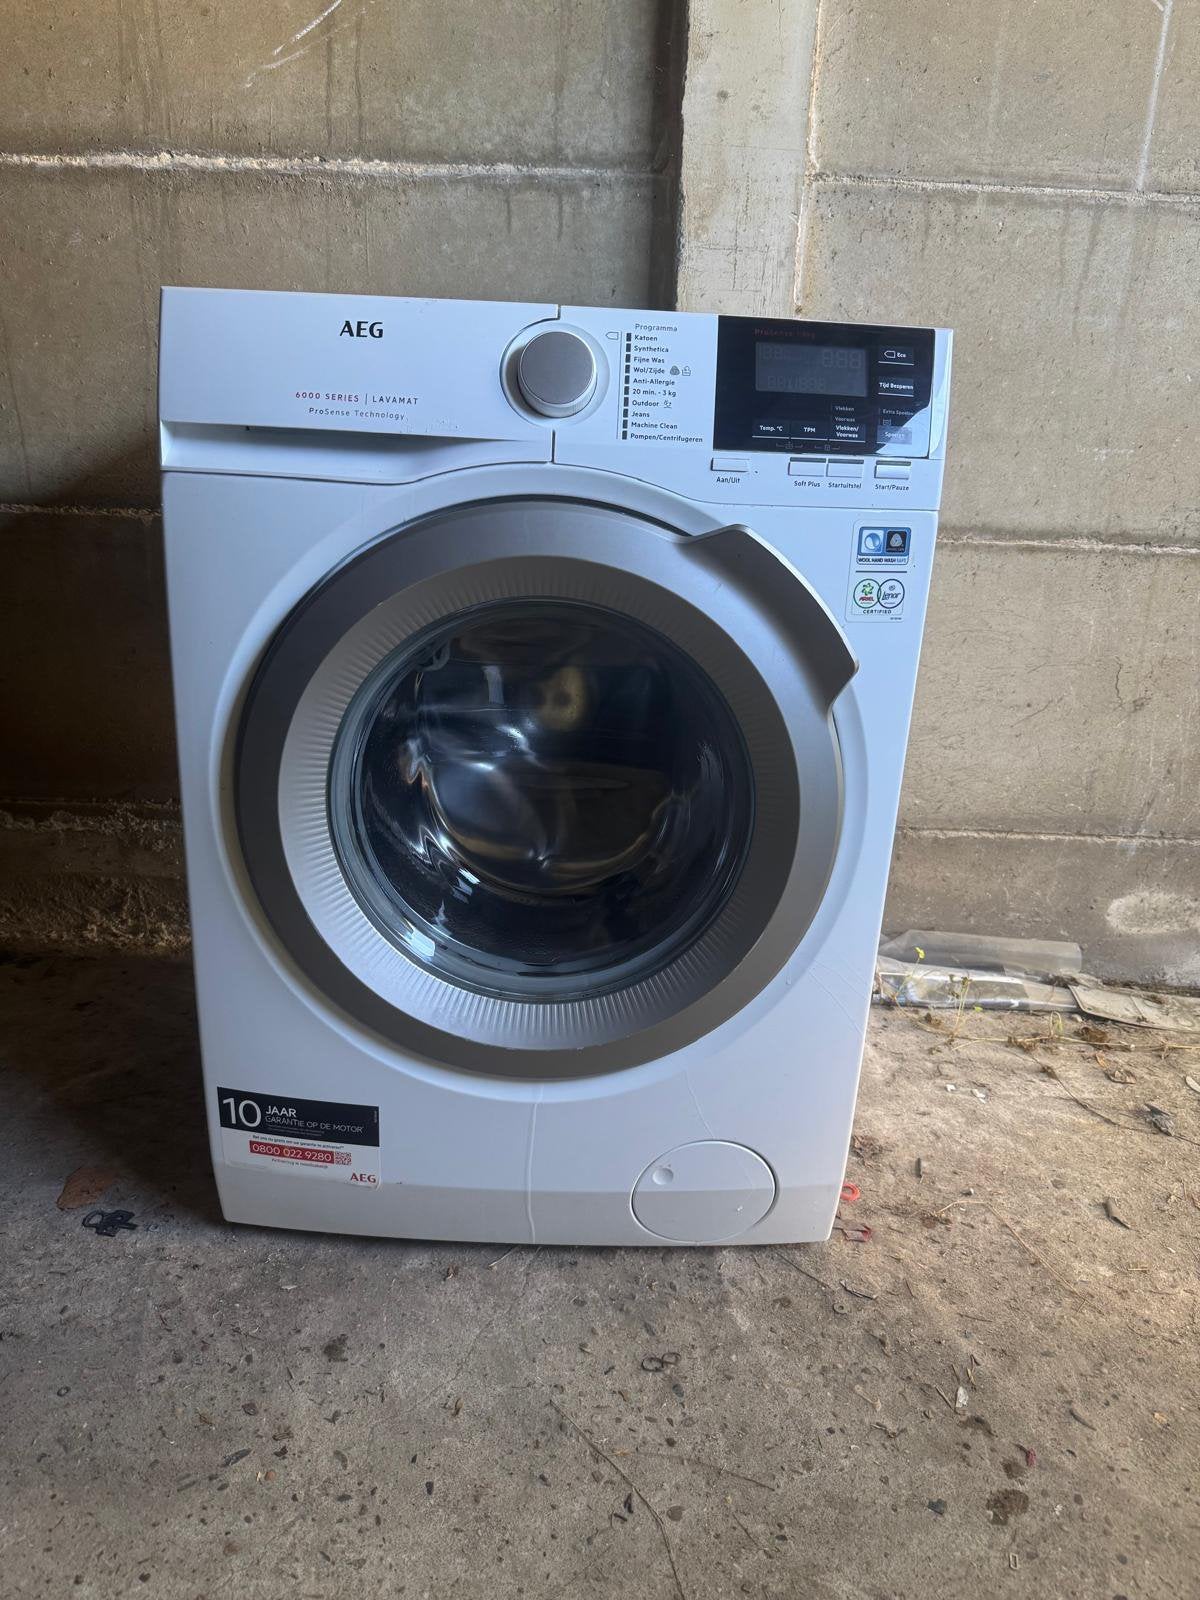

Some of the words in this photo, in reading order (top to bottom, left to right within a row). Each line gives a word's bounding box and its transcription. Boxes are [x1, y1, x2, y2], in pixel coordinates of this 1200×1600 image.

[339, 320, 384, 339] AEG
[634, 323, 678, 332] Programma
[634, 334, 658, 342] Katoen
[633, 345, 669, 353] Synthetica
[633, 356, 650, 364] Fijne
[633, 367, 665, 375] Wol/Zijde
[632, 378, 675, 387] Anti-Allergie
[890, 383, 914, 391] Besparen
[295, 391, 321, 400] 6000
[325, 393, 359, 403] SERIES
[372, 395, 419, 405] LAVAMAT
[668, 390, 677, 398] kg
[632, 399, 660, 408] Outdoor
[308, 407, 351, 417] ProSense
[354, 409, 405, 421] Technology
[631, 421, 658, 429] Machine
[659, 422, 678, 430] Clean
[630, 432, 703, 443] Pompen/Centrifugeren
[716, 476, 741, 485] Aan/Uit
[794, 480, 807, 488] Soft
[828, 482, 862, 490] Startuitstel
[875, 483, 910, 492] Start/Pauze
[222, 1097, 262, 1128] 10
[265, 1105, 297, 1117] JAAR
[265, 1115, 304, 1127] GARANTIE
[306, 1121, 318, 1129] OP
[320, 1123, 331, 1131] DE
[252, 1143, 281, 1156] 0800
[283, 1148, 303, 1159] 022
[304, 1150, 332, 1162] 9280
[350, 1172, 377, 1184] AEG
